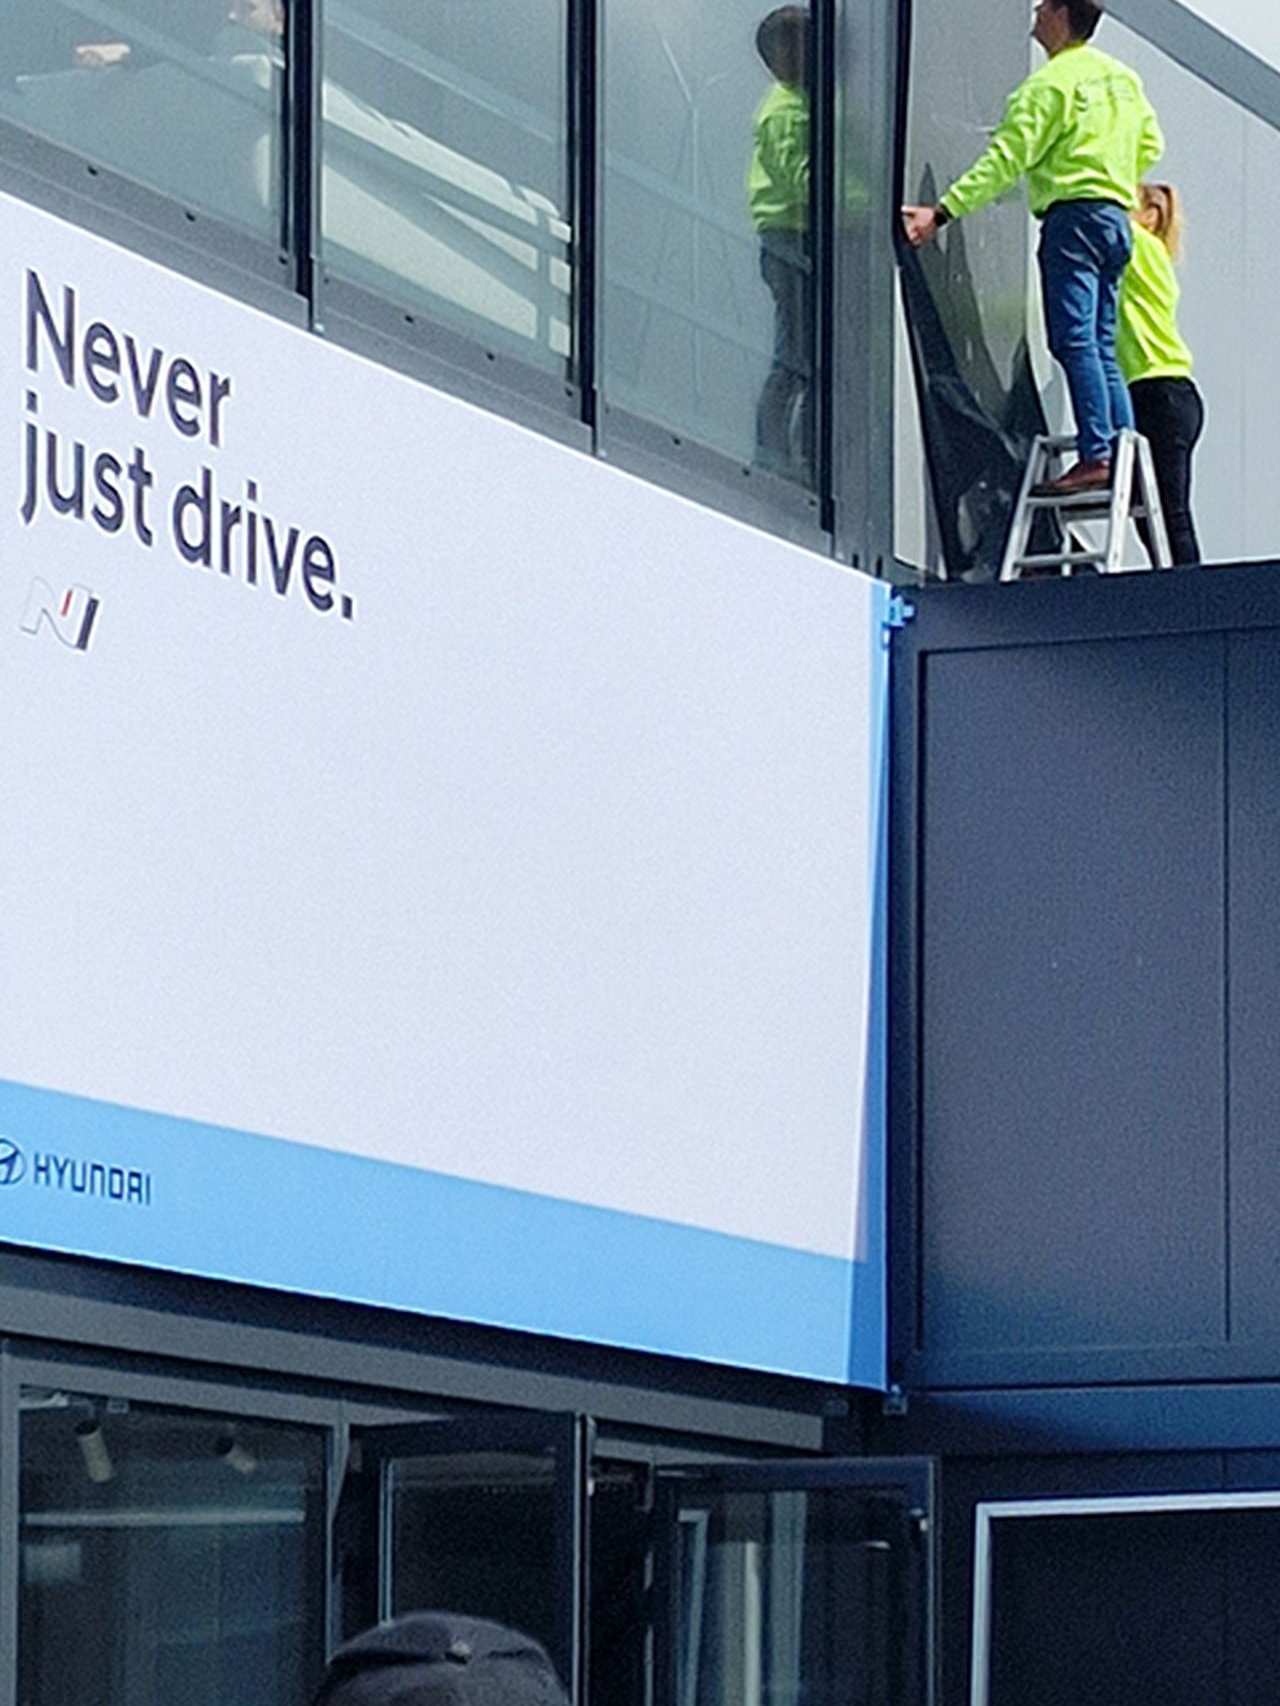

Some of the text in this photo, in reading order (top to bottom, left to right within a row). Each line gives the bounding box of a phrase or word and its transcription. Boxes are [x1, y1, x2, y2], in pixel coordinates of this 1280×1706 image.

[26, 267, 231, 447] Never
[20, 390, 354, 620] just drive.
[34, 1152, 151, 1207] HYUNDAI
